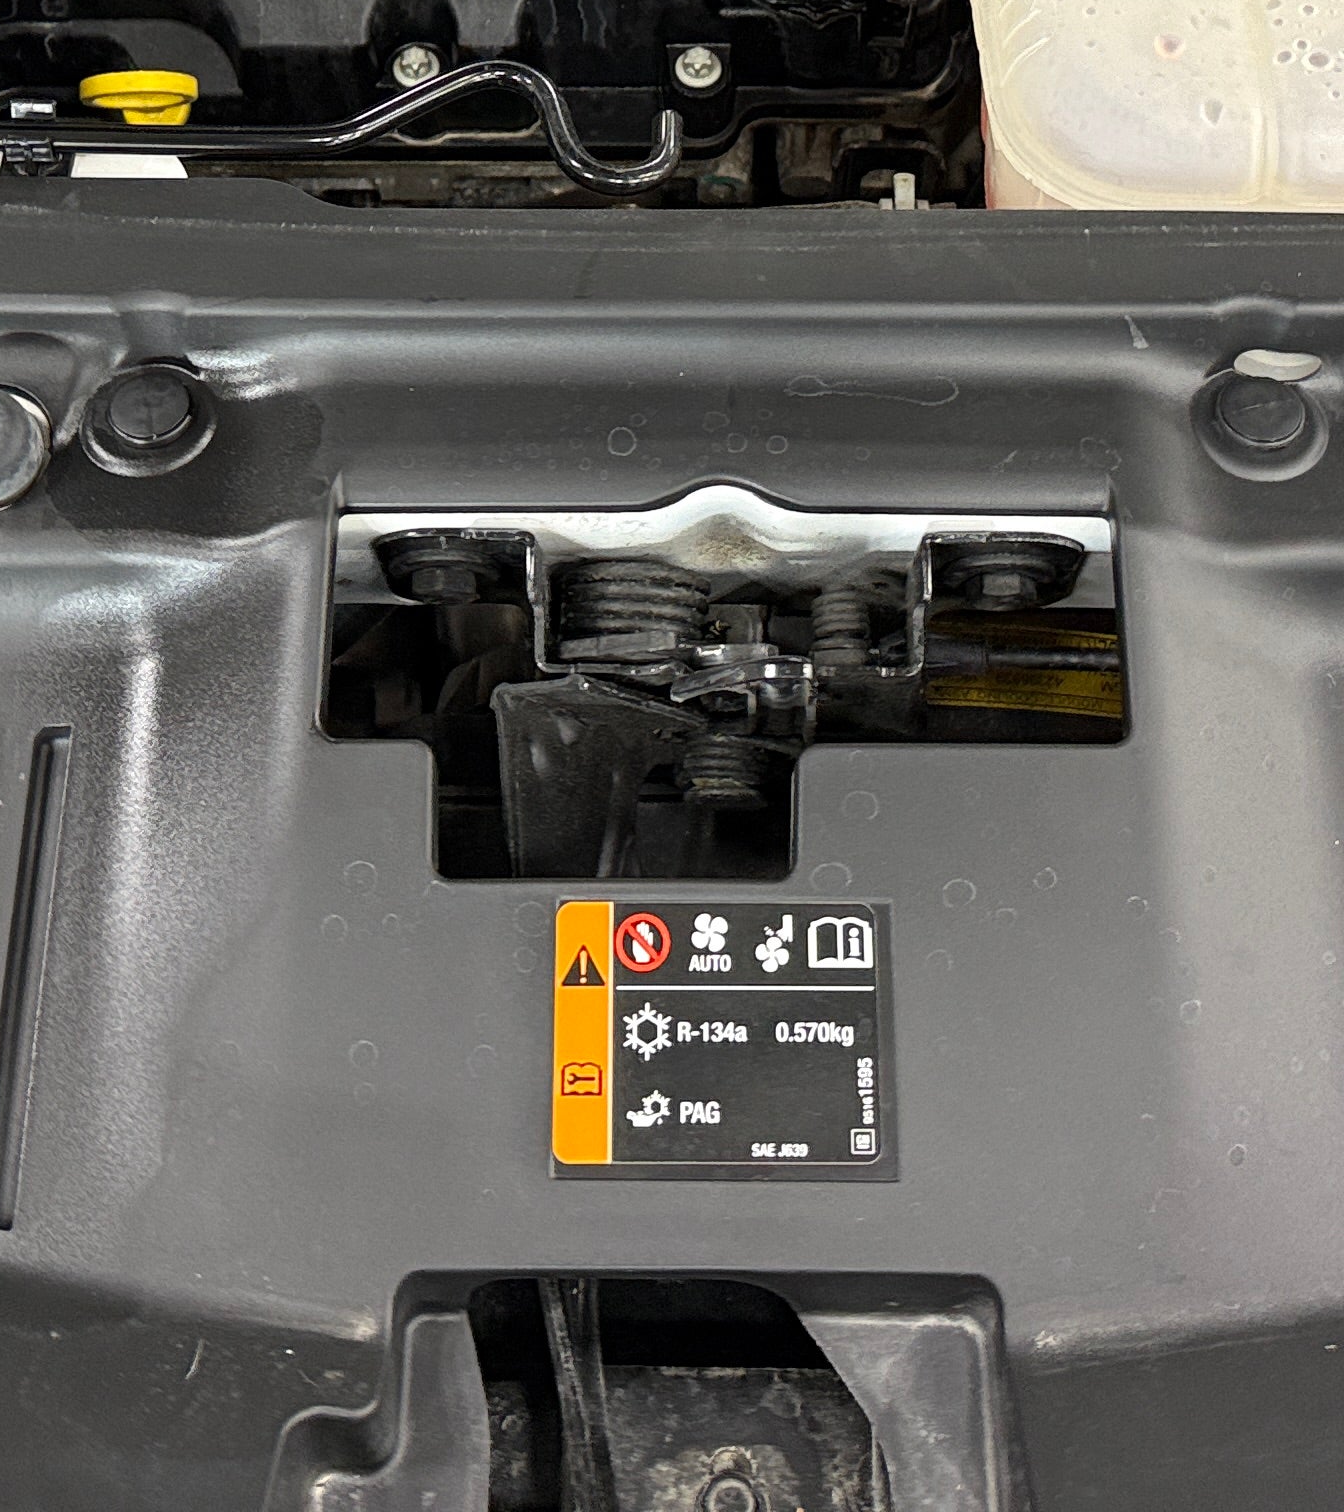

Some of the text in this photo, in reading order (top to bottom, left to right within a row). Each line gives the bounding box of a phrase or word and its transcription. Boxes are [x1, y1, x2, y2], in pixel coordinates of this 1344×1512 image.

[688, 954, 732, 973] AUTO
[676, 1021, 855, 1047] R-134a 0.570kg
[679, 1101, 721, 1124] PAG
[751, 1143, 776, 1157] SAE
